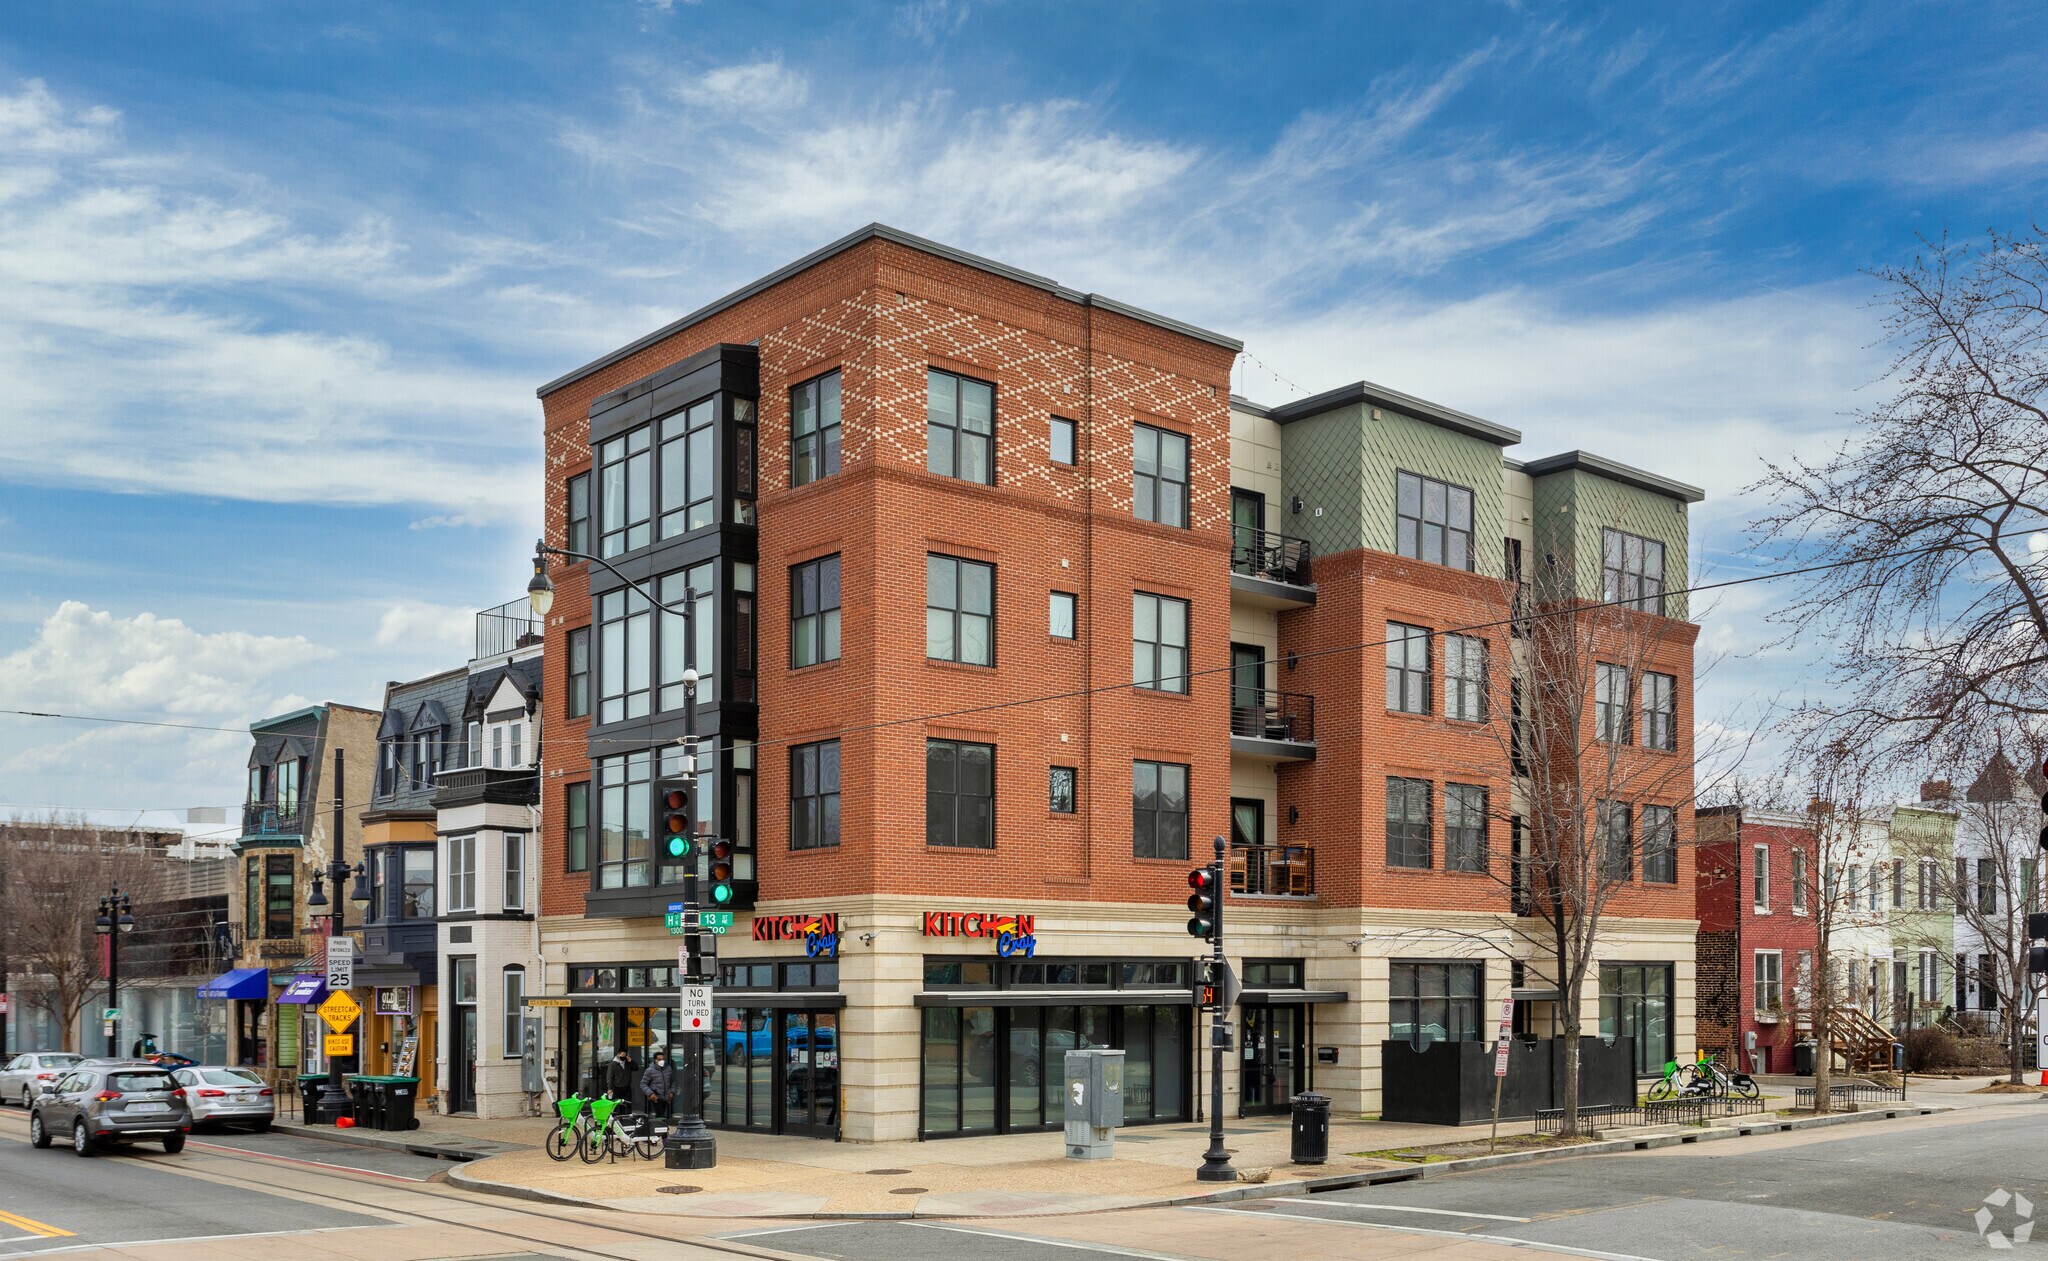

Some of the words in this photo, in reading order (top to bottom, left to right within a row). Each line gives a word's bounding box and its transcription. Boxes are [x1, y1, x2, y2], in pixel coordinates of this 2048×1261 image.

[667, 915, 674, 926] H
[705, 914, 716, 924] 13
[806, 933, 837, 957] Cray
[1000, 932, 1037, 958] Cray
[330, 973, 350, 986] 25
[382, 992, 395, 1004] OLD
[689, 989, 704, 998] NO
[688, 999, 706, 1007] TURN
[323, 1005, 357, 1013] STREETCAR
[684, 1008, 693, 1016] ON
[696, 1008, 709, 1016] RED
[328, 1014, 352, 1022] TRACKS
